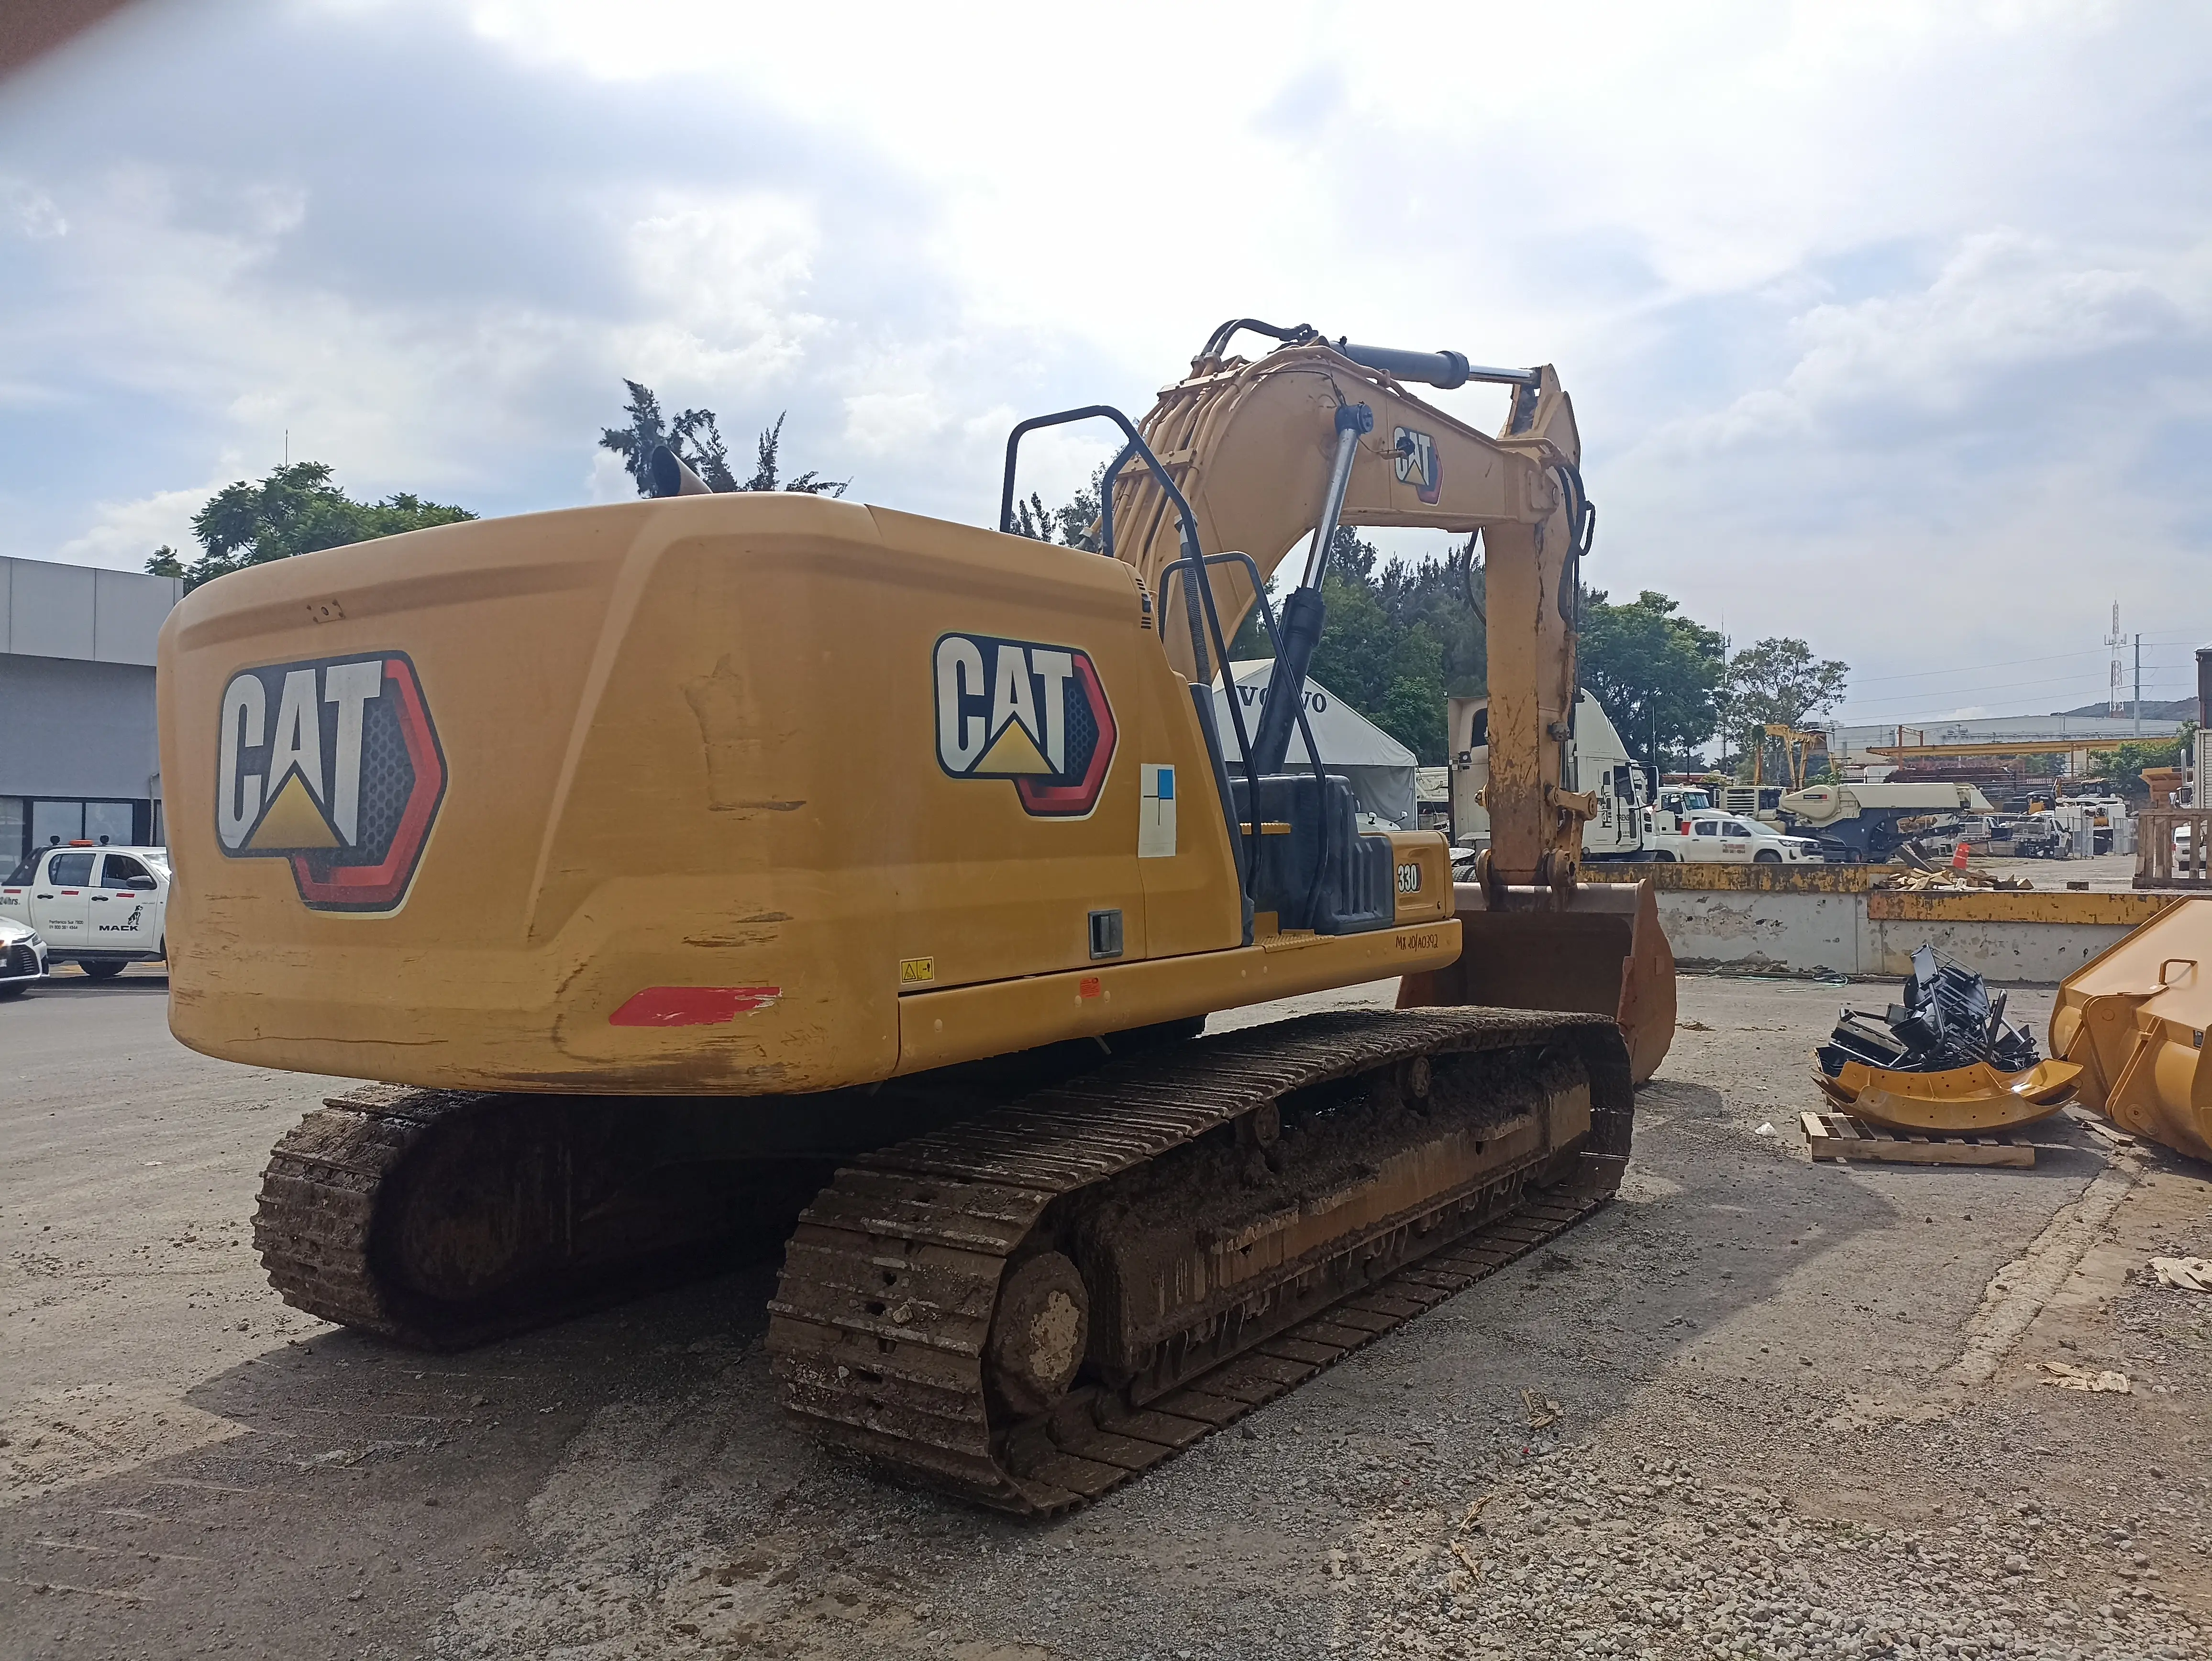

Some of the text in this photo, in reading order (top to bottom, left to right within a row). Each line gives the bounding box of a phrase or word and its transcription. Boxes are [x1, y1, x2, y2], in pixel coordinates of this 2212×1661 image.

[937, 637, 1073, 774] CAT
[218, 660, 382, 849] CAT
[1398, 864, 1417, 892] 330
[1396, 935, 1406, 950] MX
